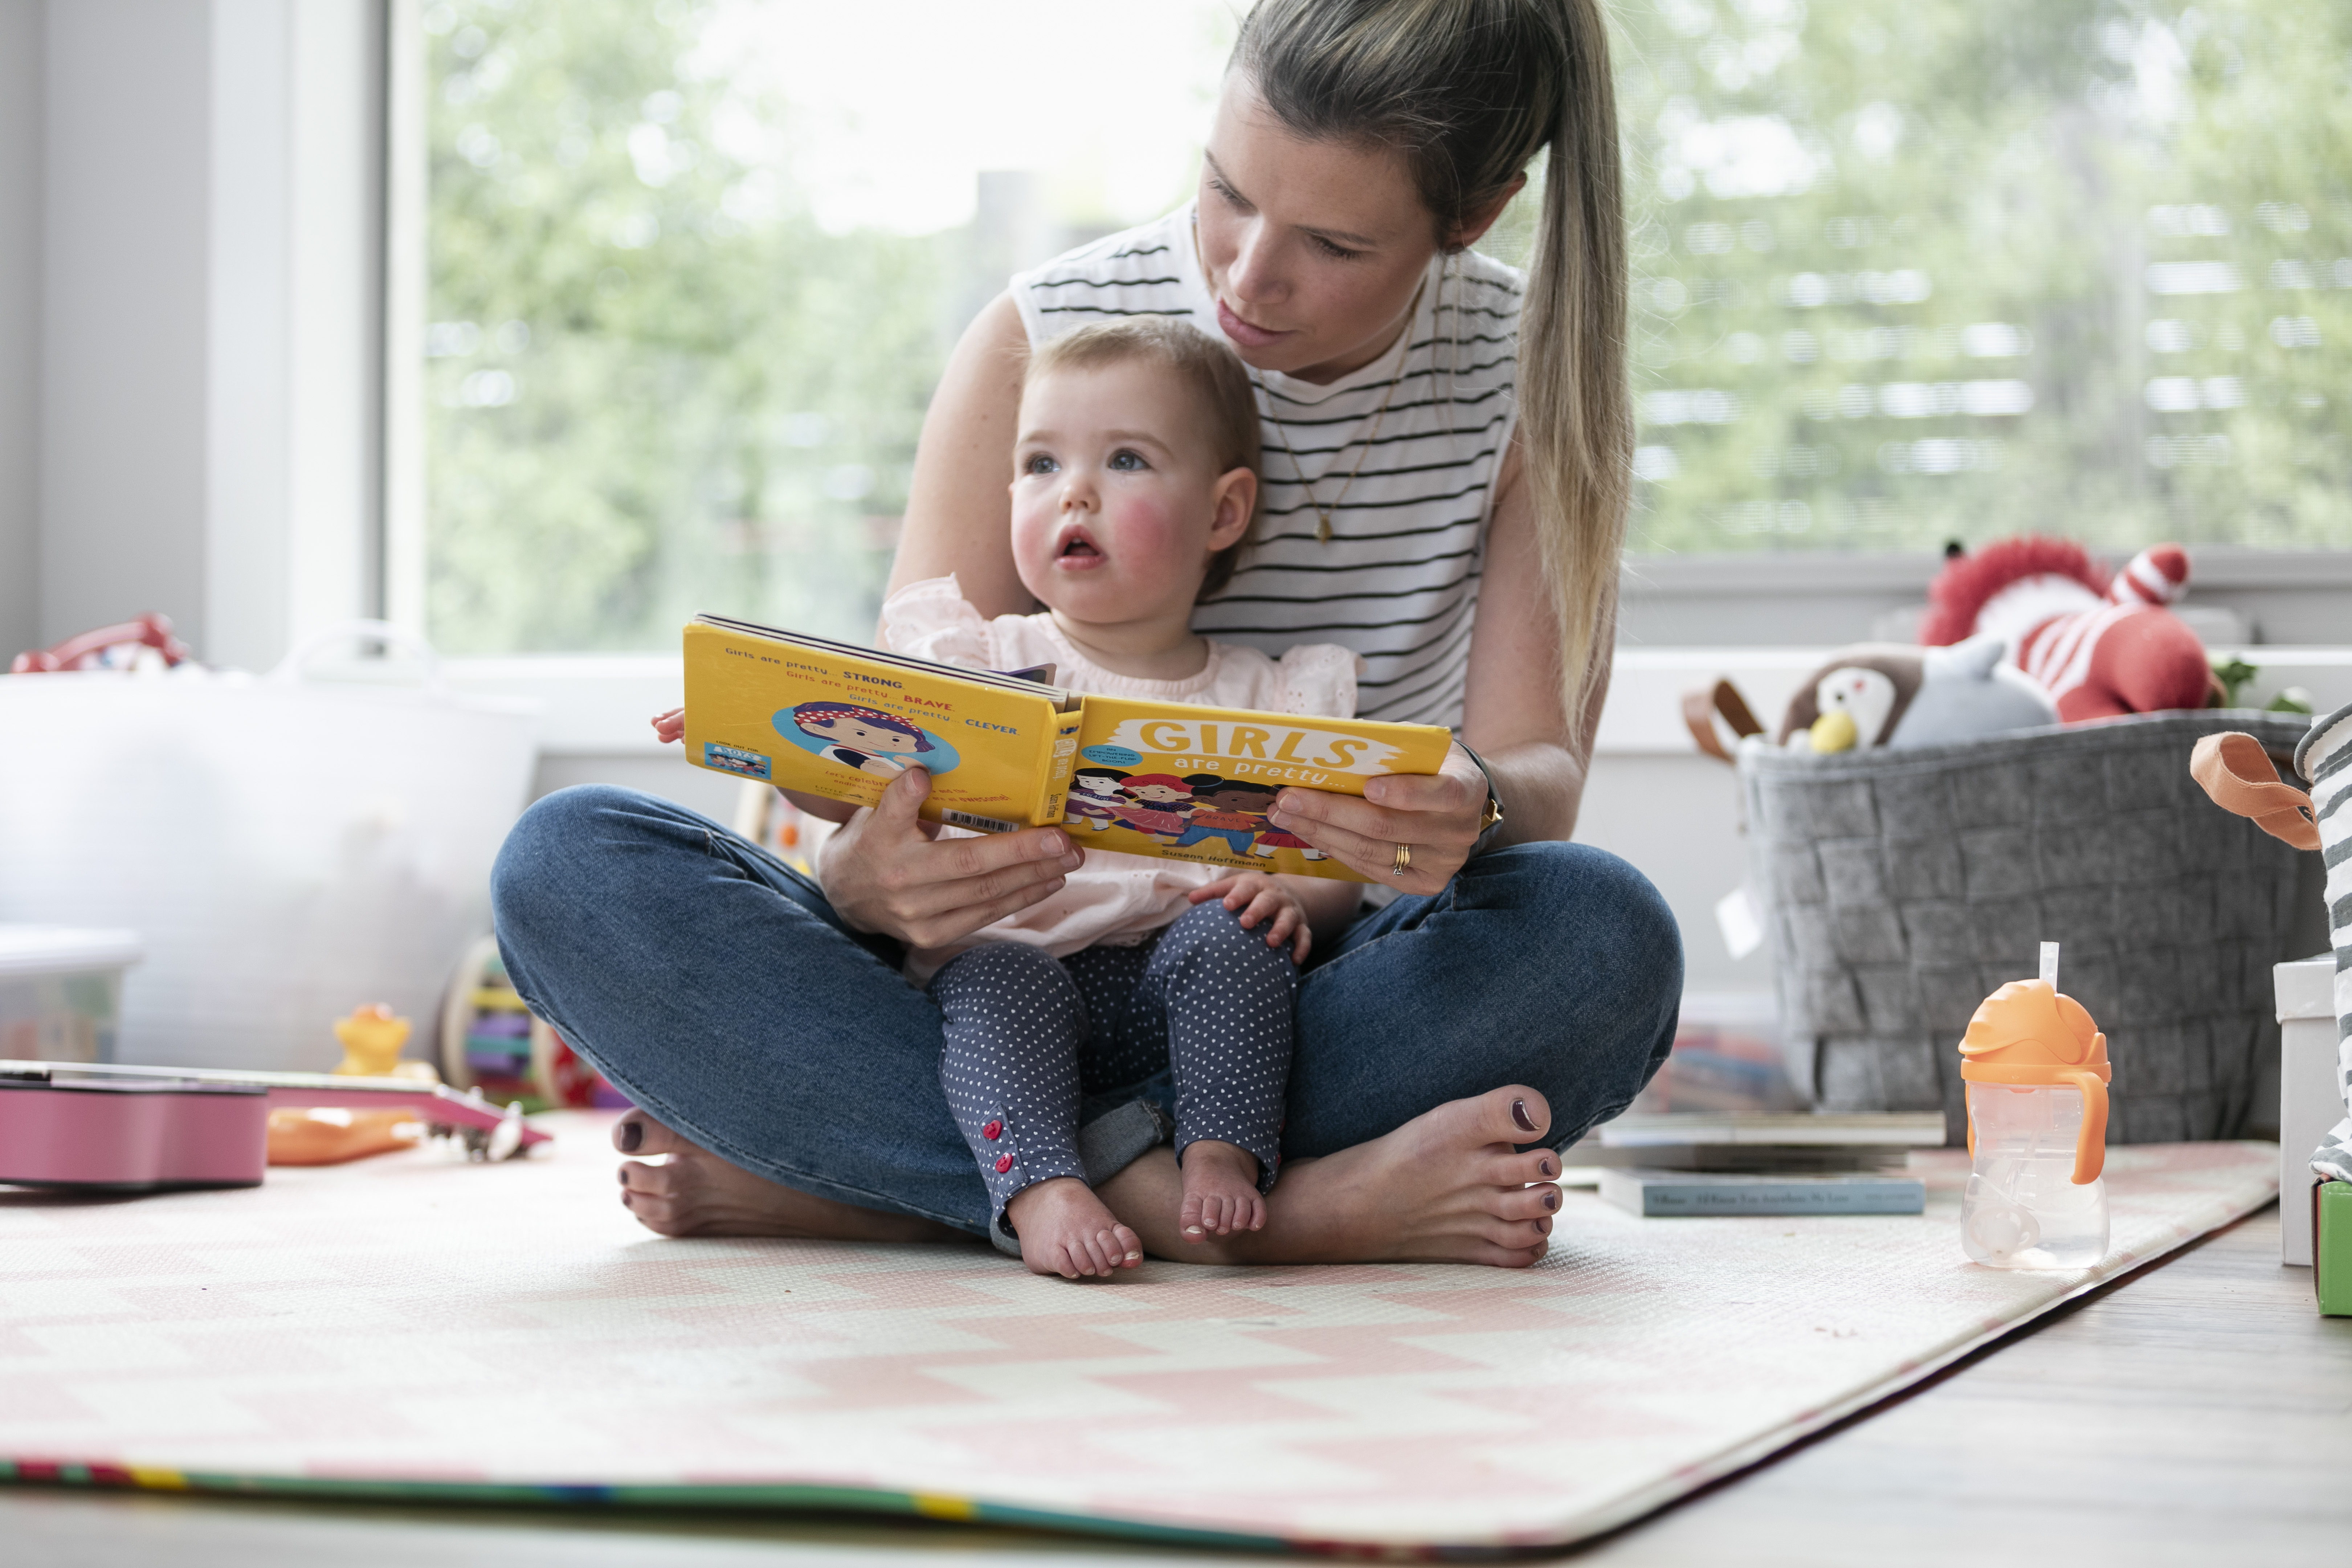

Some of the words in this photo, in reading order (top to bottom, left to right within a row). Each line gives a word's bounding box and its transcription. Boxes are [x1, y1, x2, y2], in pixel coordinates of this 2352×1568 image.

[725, 648, 755, 659] Girls
[760, 656, 781, 665] are
[843, 671, 906, 690] STRONG.
[787, 671, 816, 682] Girls
[821, 679, 841, 687] are
[903, 695, 955, 712] BRAVE.
[849, 694, 878, 705] Girls
[884, 702, 903, 711] are
[965, 719, 1020, 735] CLEVER.
[1139, 721, 1369, 769] GIRLS
[1174, 756, 1220, 770] are
[825, 770, 845, 779] Let's
[834, 779, 866, 790] endless
[959, 793, 1012, 802] awesome!
[1083, 792, 1111, 801] CREATIVE
[1205, 814, 1241, 823] BRAVE
[1162, 849, 1204, 860] Susann
[1208, 855, 1266, 867] Hoffmann
